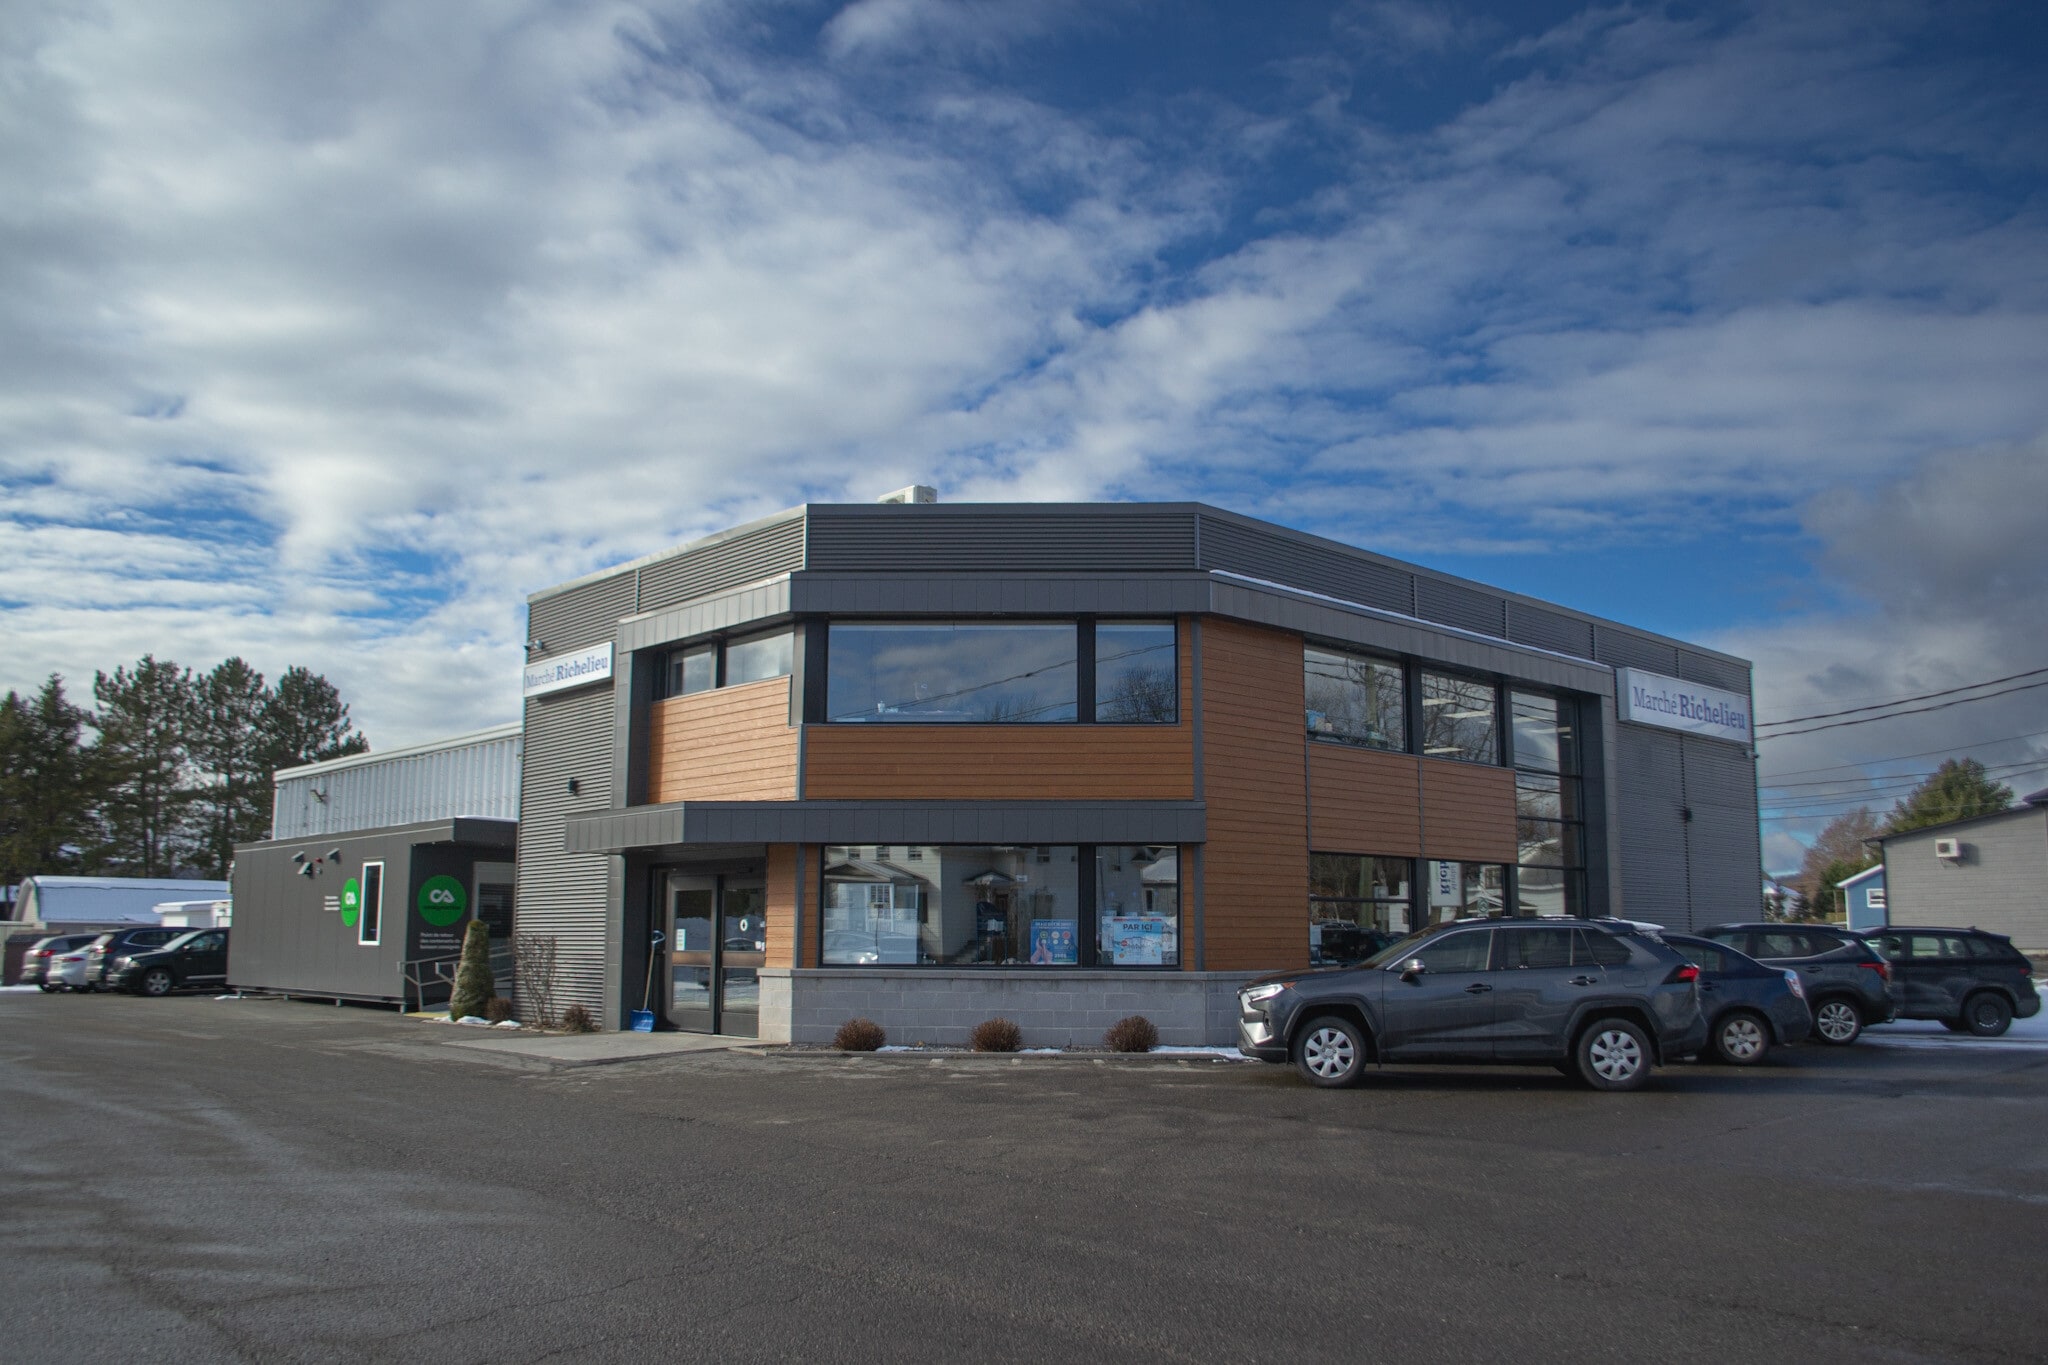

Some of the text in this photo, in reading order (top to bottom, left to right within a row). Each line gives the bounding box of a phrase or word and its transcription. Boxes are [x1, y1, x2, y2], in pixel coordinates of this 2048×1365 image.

[556, 656, 608, 680] Richelieu
[1633, 686, 1746, 729] Marché Richelieu
